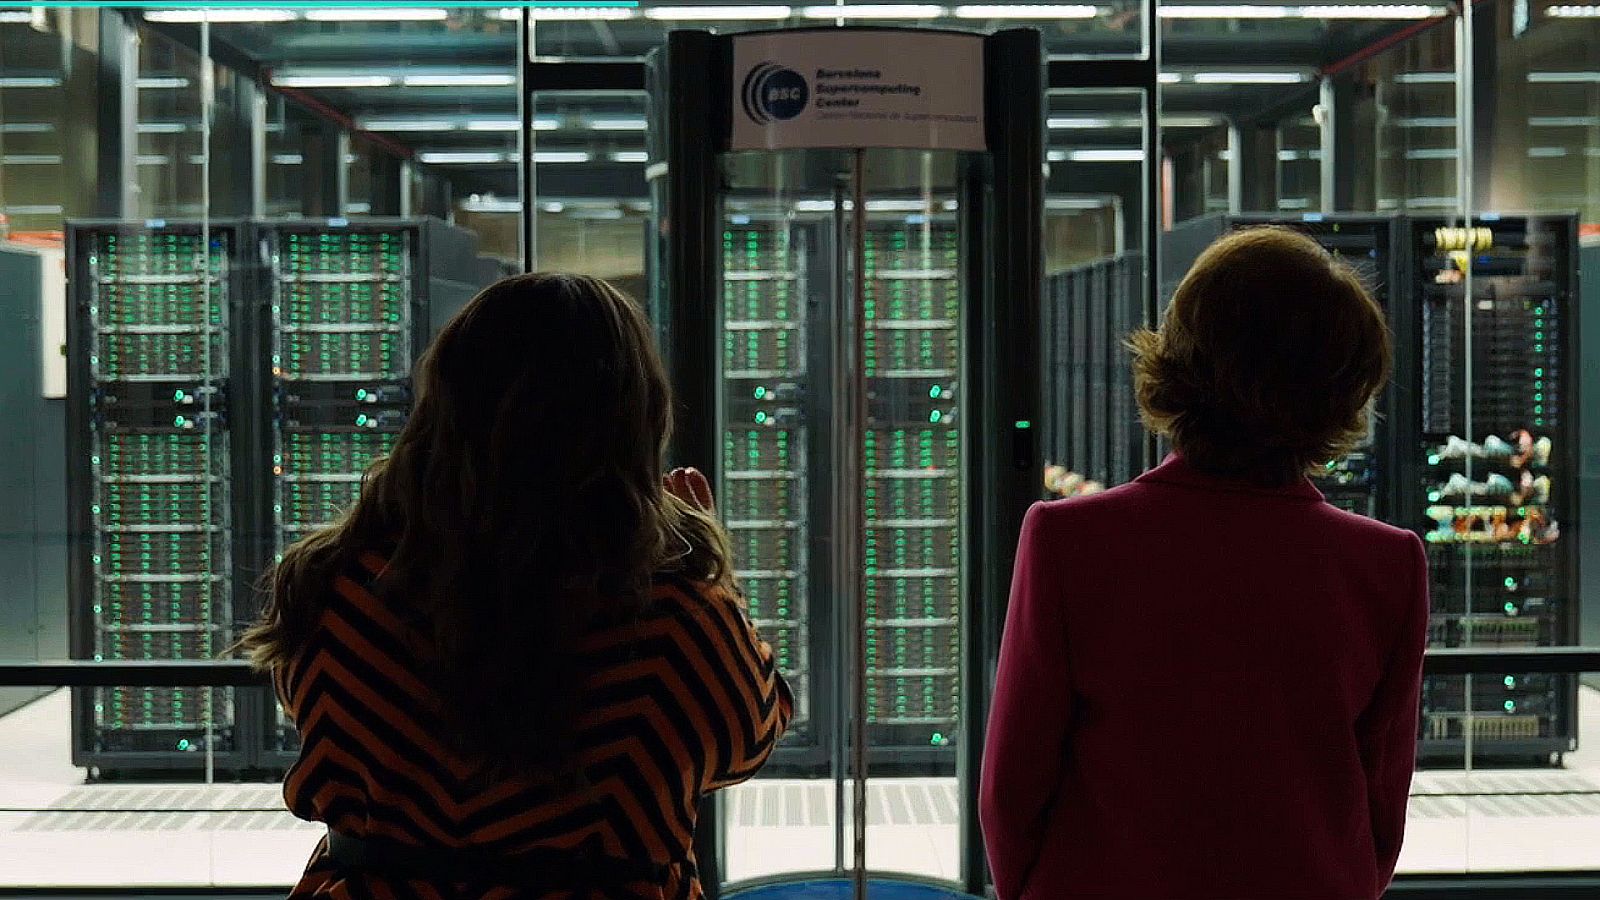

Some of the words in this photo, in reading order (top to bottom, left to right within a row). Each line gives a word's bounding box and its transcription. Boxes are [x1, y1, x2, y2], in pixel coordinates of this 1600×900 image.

[816, 68, 881, 79] Barcelona
[769, 87, 801, 102] BSC
[816, 82, 921, 96] Supercomputing
[816, 98, 859, 108] Center
